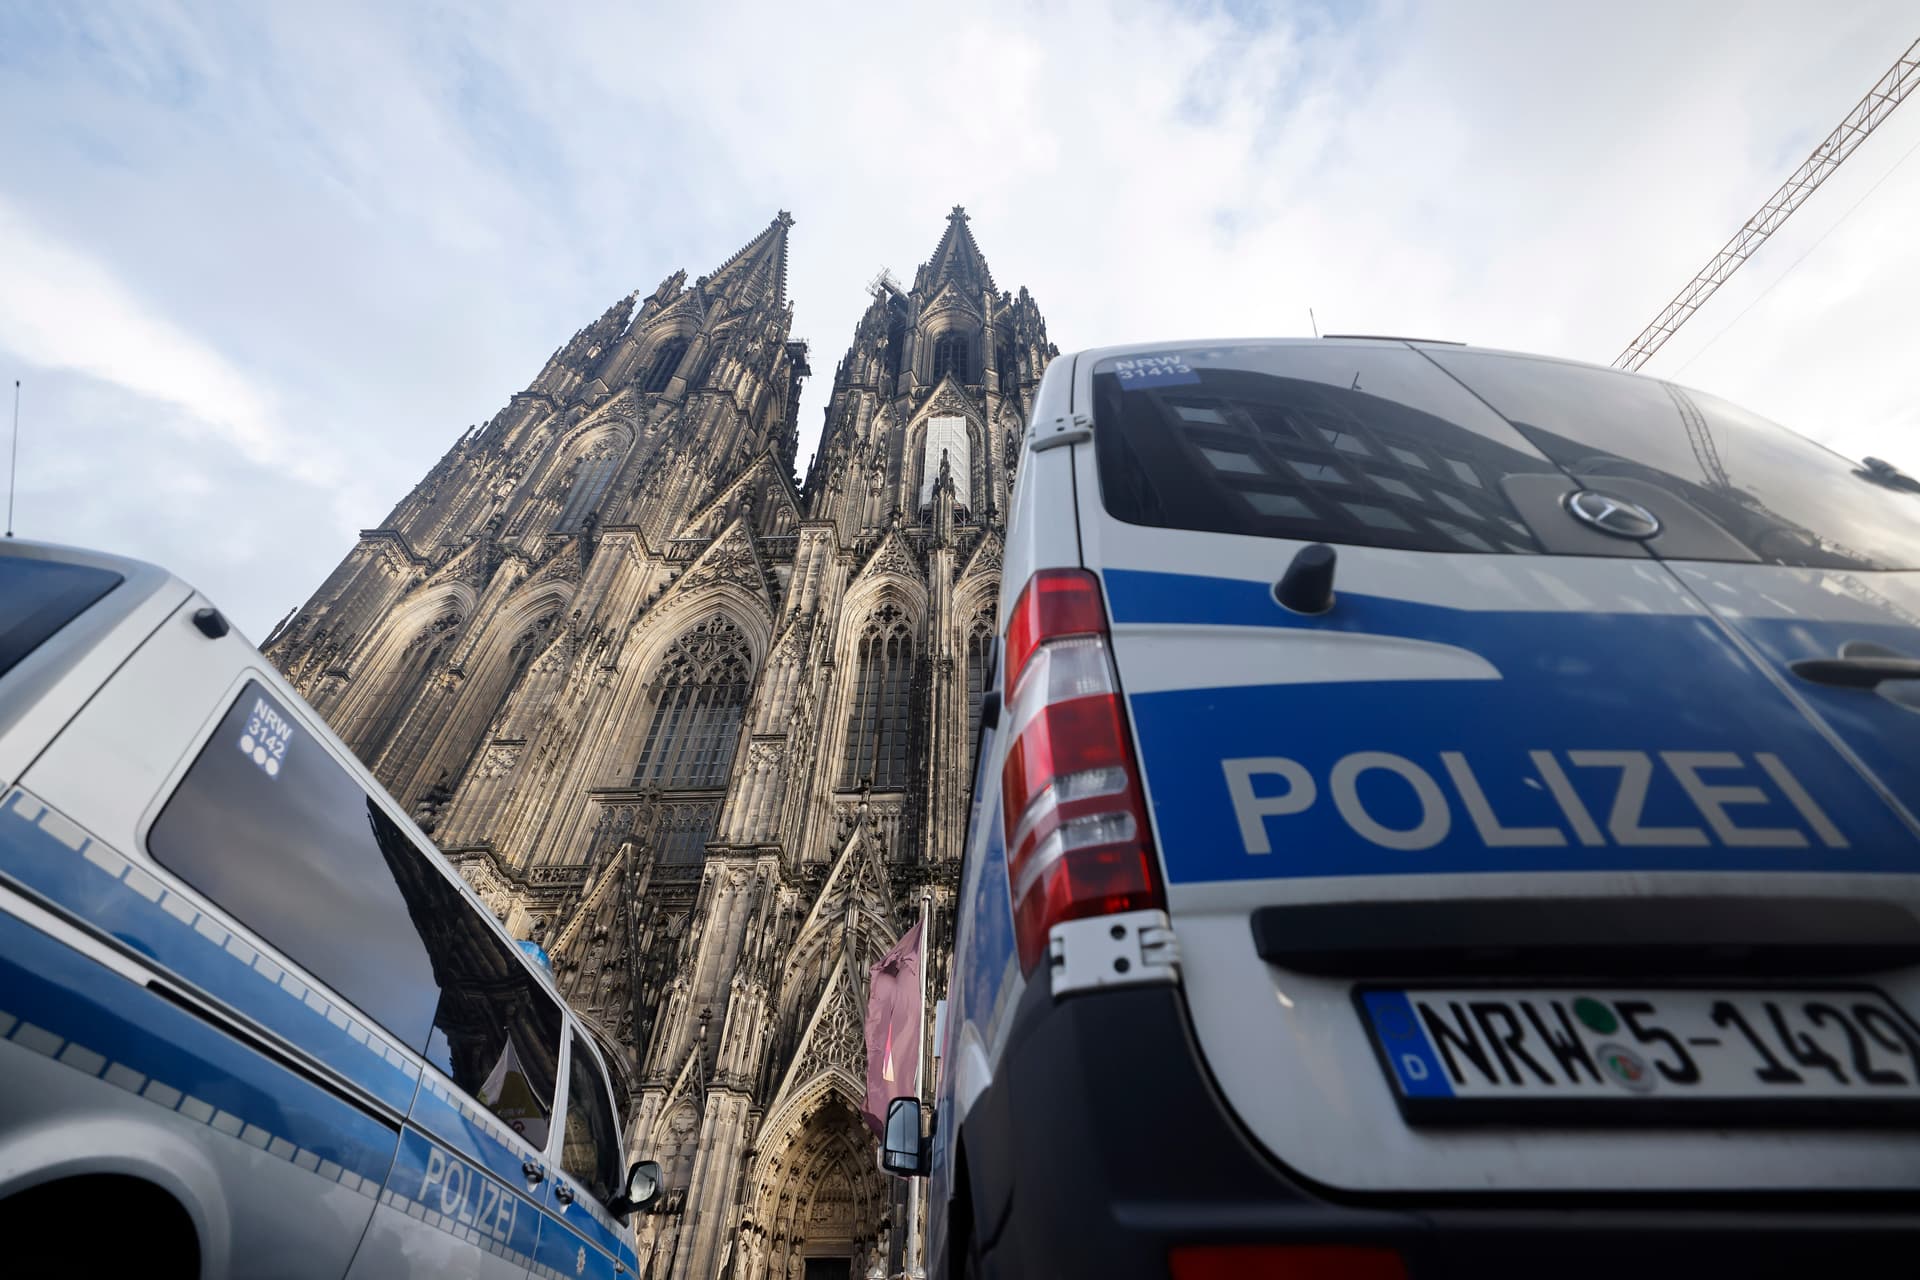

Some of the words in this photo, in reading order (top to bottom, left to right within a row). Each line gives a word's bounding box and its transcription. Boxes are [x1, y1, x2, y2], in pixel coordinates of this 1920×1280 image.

[1115, 355, 1181, 371] NRW
[248, 718, 285, 760] 3142
[254, 698, 293, 741] NRW
[1222, 751, 1851, 854] POLIZEI
[1417, 1001, 1603, 1085] NRW
[1402, 1053, 1428, 1081] D
[418, 1147, 519, 1245] POLIZEI
